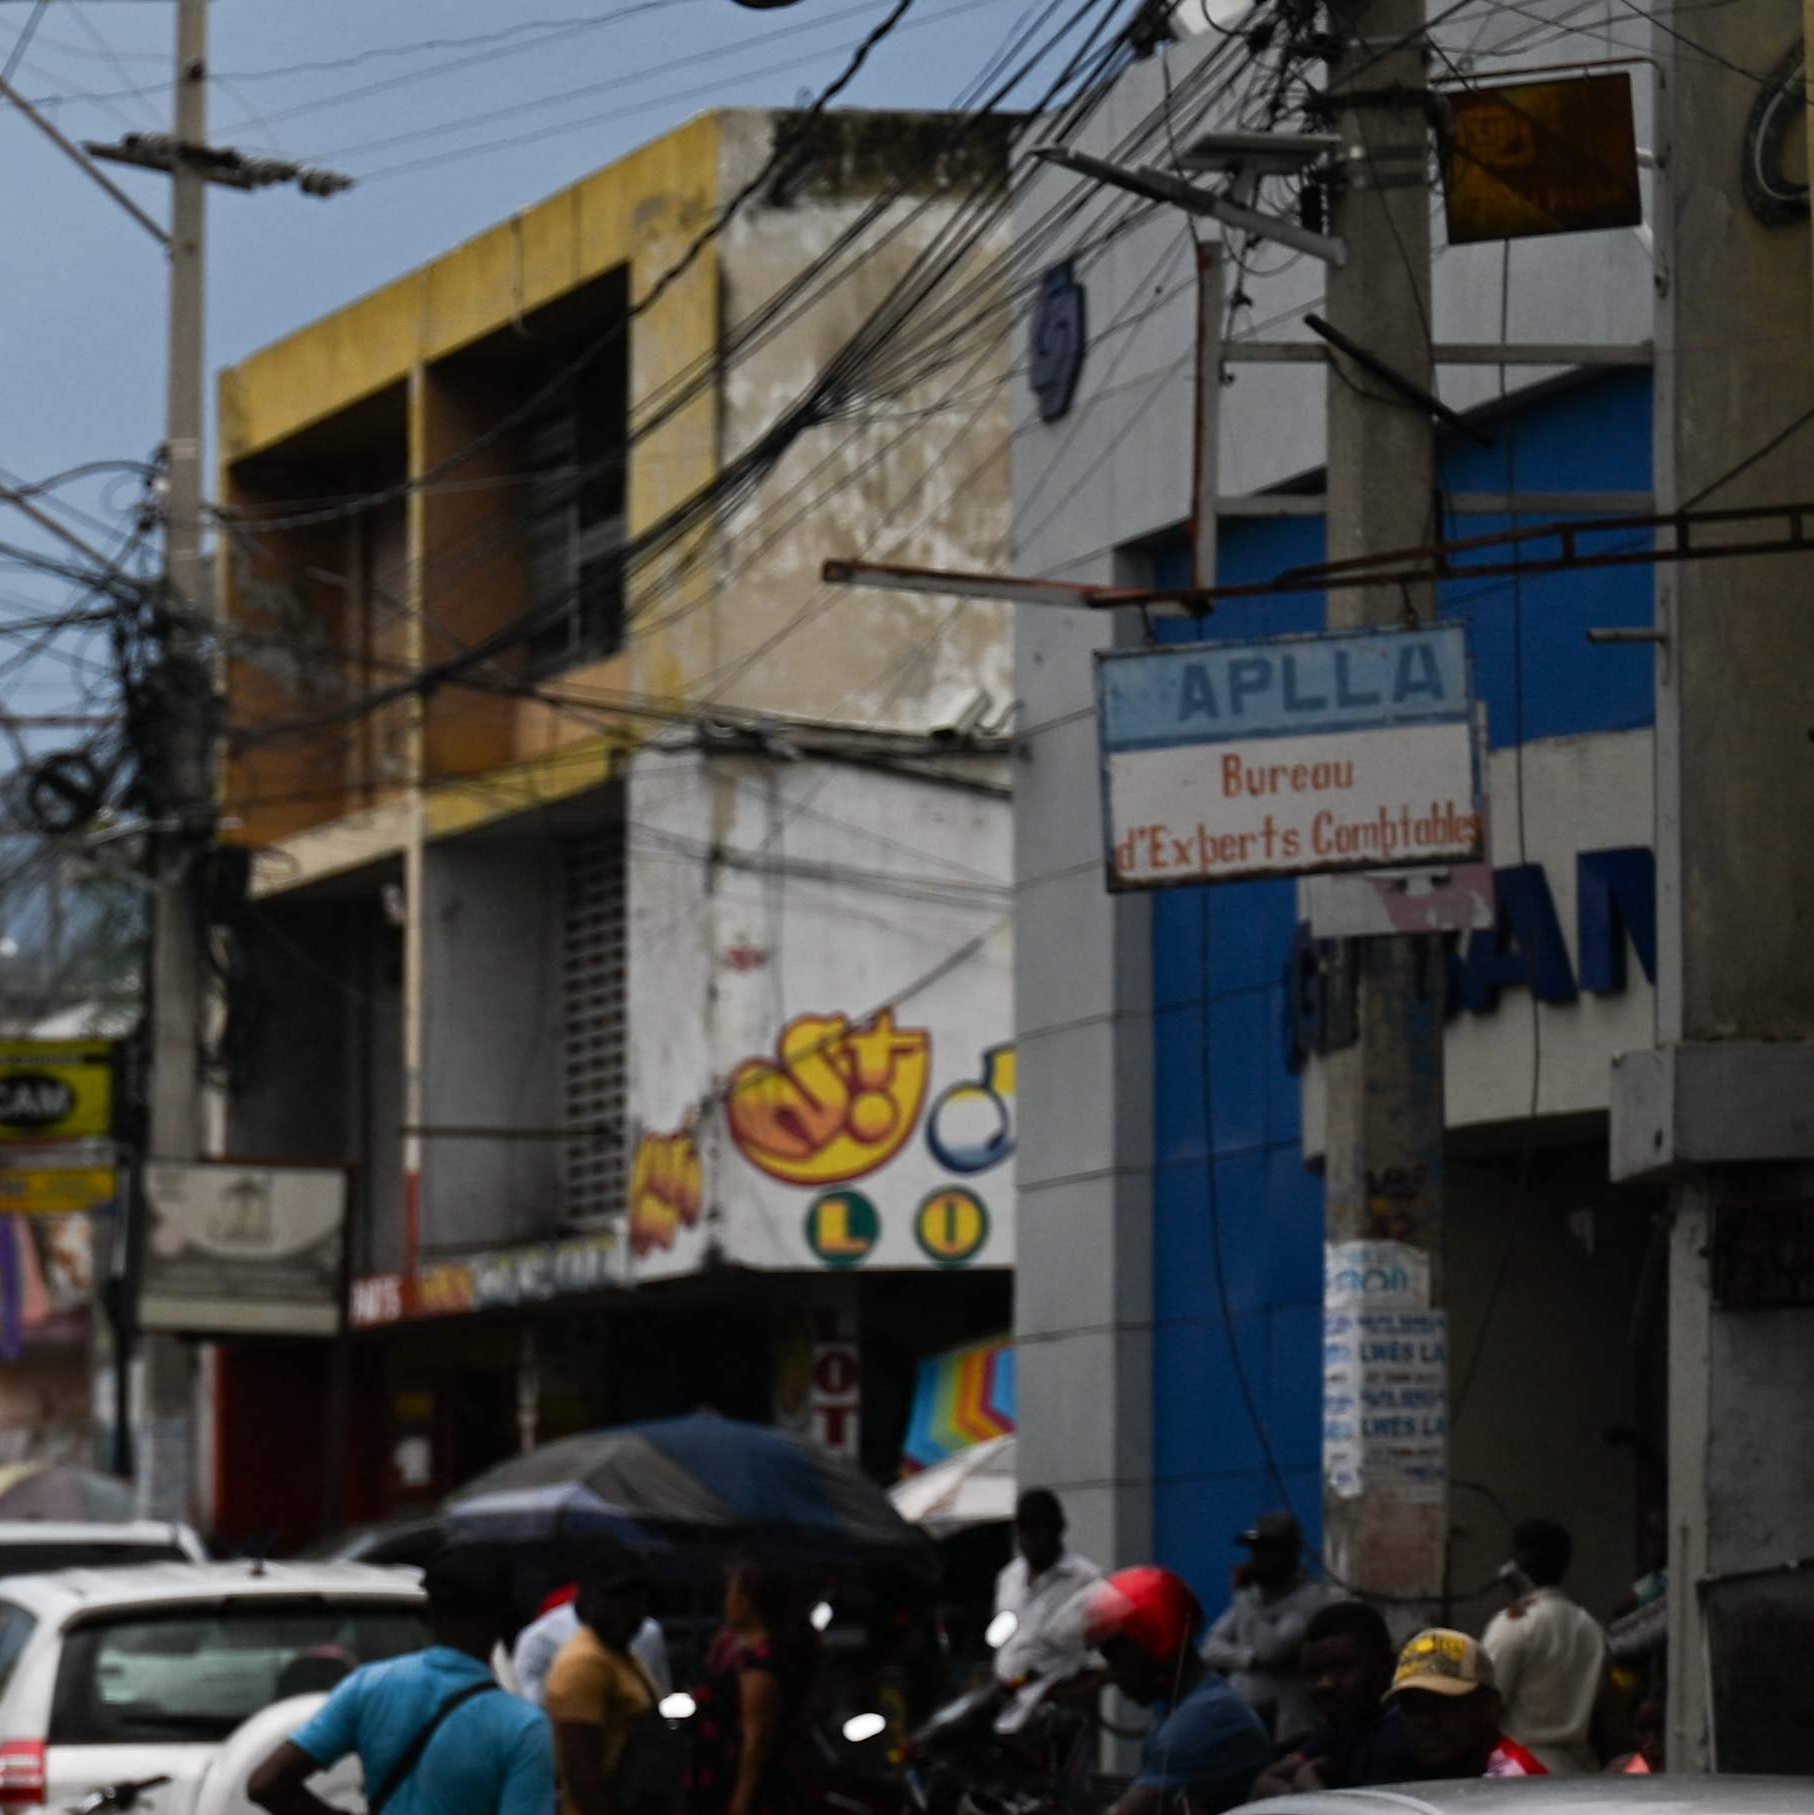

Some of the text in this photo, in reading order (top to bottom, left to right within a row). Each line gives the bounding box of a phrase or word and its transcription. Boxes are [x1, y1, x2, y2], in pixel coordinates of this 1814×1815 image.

[1178, 643, 1444, 721] APLLA
[1222, 753, 1354, 798] Bureau
[1311, 801, 1483, 858] Comptables
